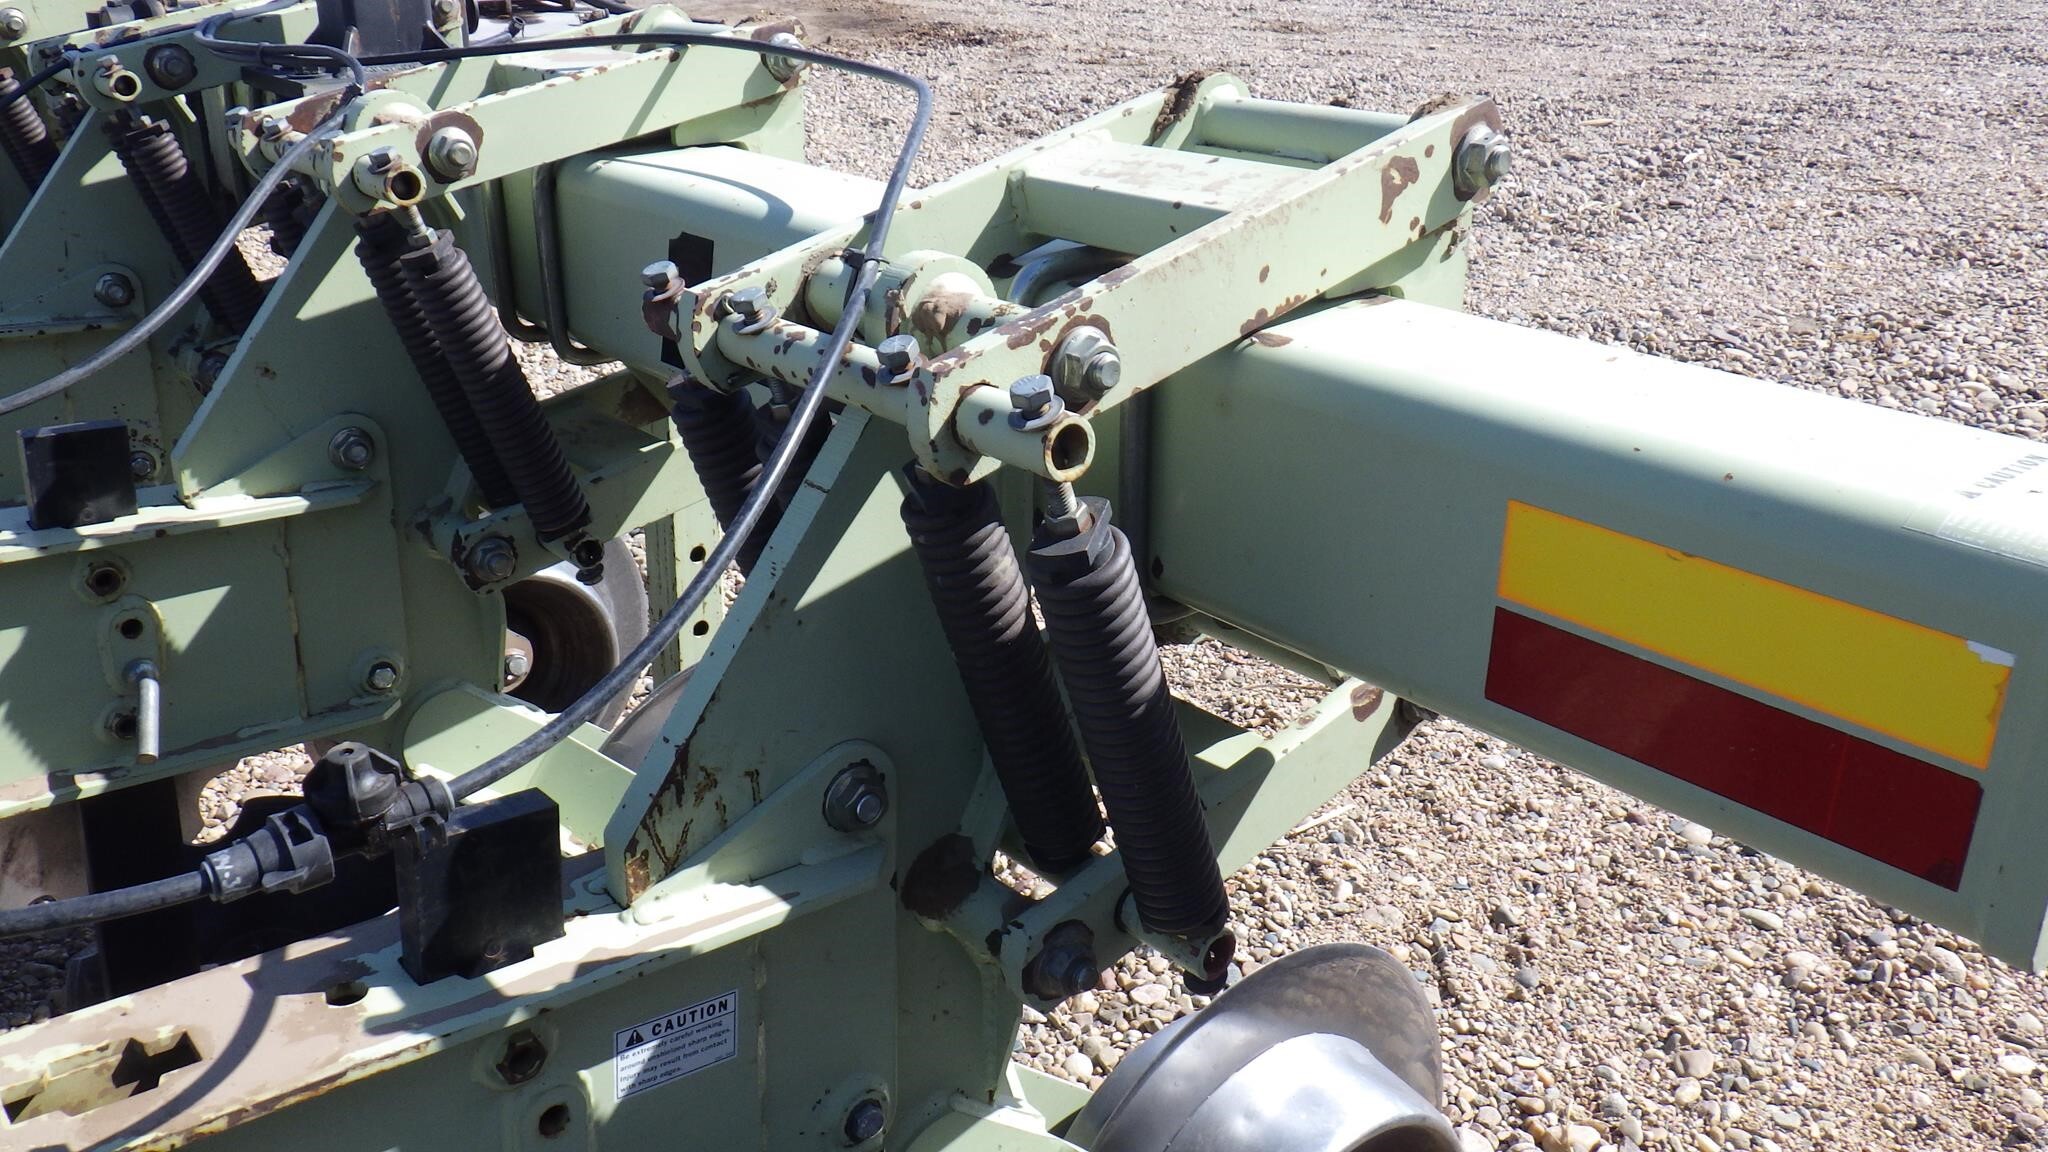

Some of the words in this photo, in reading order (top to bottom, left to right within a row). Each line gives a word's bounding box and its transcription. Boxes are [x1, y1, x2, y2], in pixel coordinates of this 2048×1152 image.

[652, 999, 728, 1036] CAUTION
[620, 1058, 646, 1072] around
[688, 1035, 708, 1048] sharp
[632, 1039, 668, 1058] extremely
[670, 1030, 694, 1044] careful
[696, 1020, 723, 1034] working
[643, 1065, 658, 1075] may
[660, 1054, 681, 1068] result
[683, 1048, 699, 1060] from
[701, 1038, 728, 1053] contact
[620, 1082, 637, 1093] with
[638, 1074, 658, 1087] sharp
